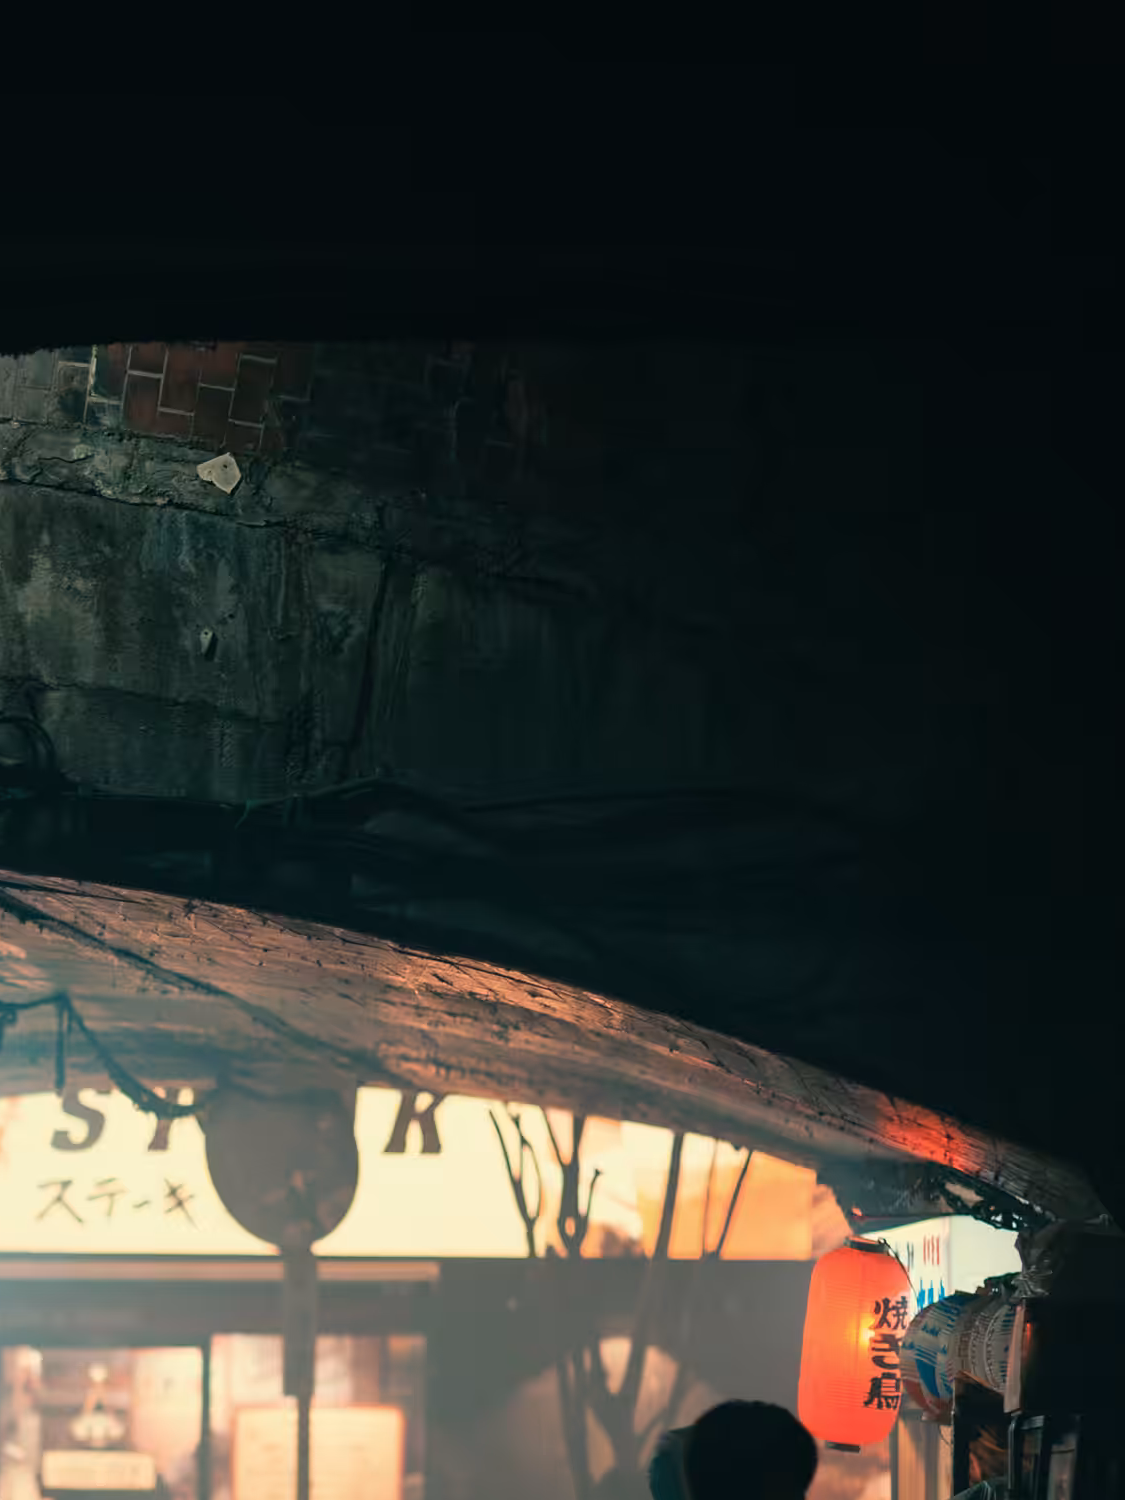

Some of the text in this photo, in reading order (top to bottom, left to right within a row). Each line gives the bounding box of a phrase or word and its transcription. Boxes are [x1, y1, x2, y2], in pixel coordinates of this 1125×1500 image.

[36, 1177, 200, 1230] ステーキ
[863, 1296, 909, 1410] 焼き鳥
